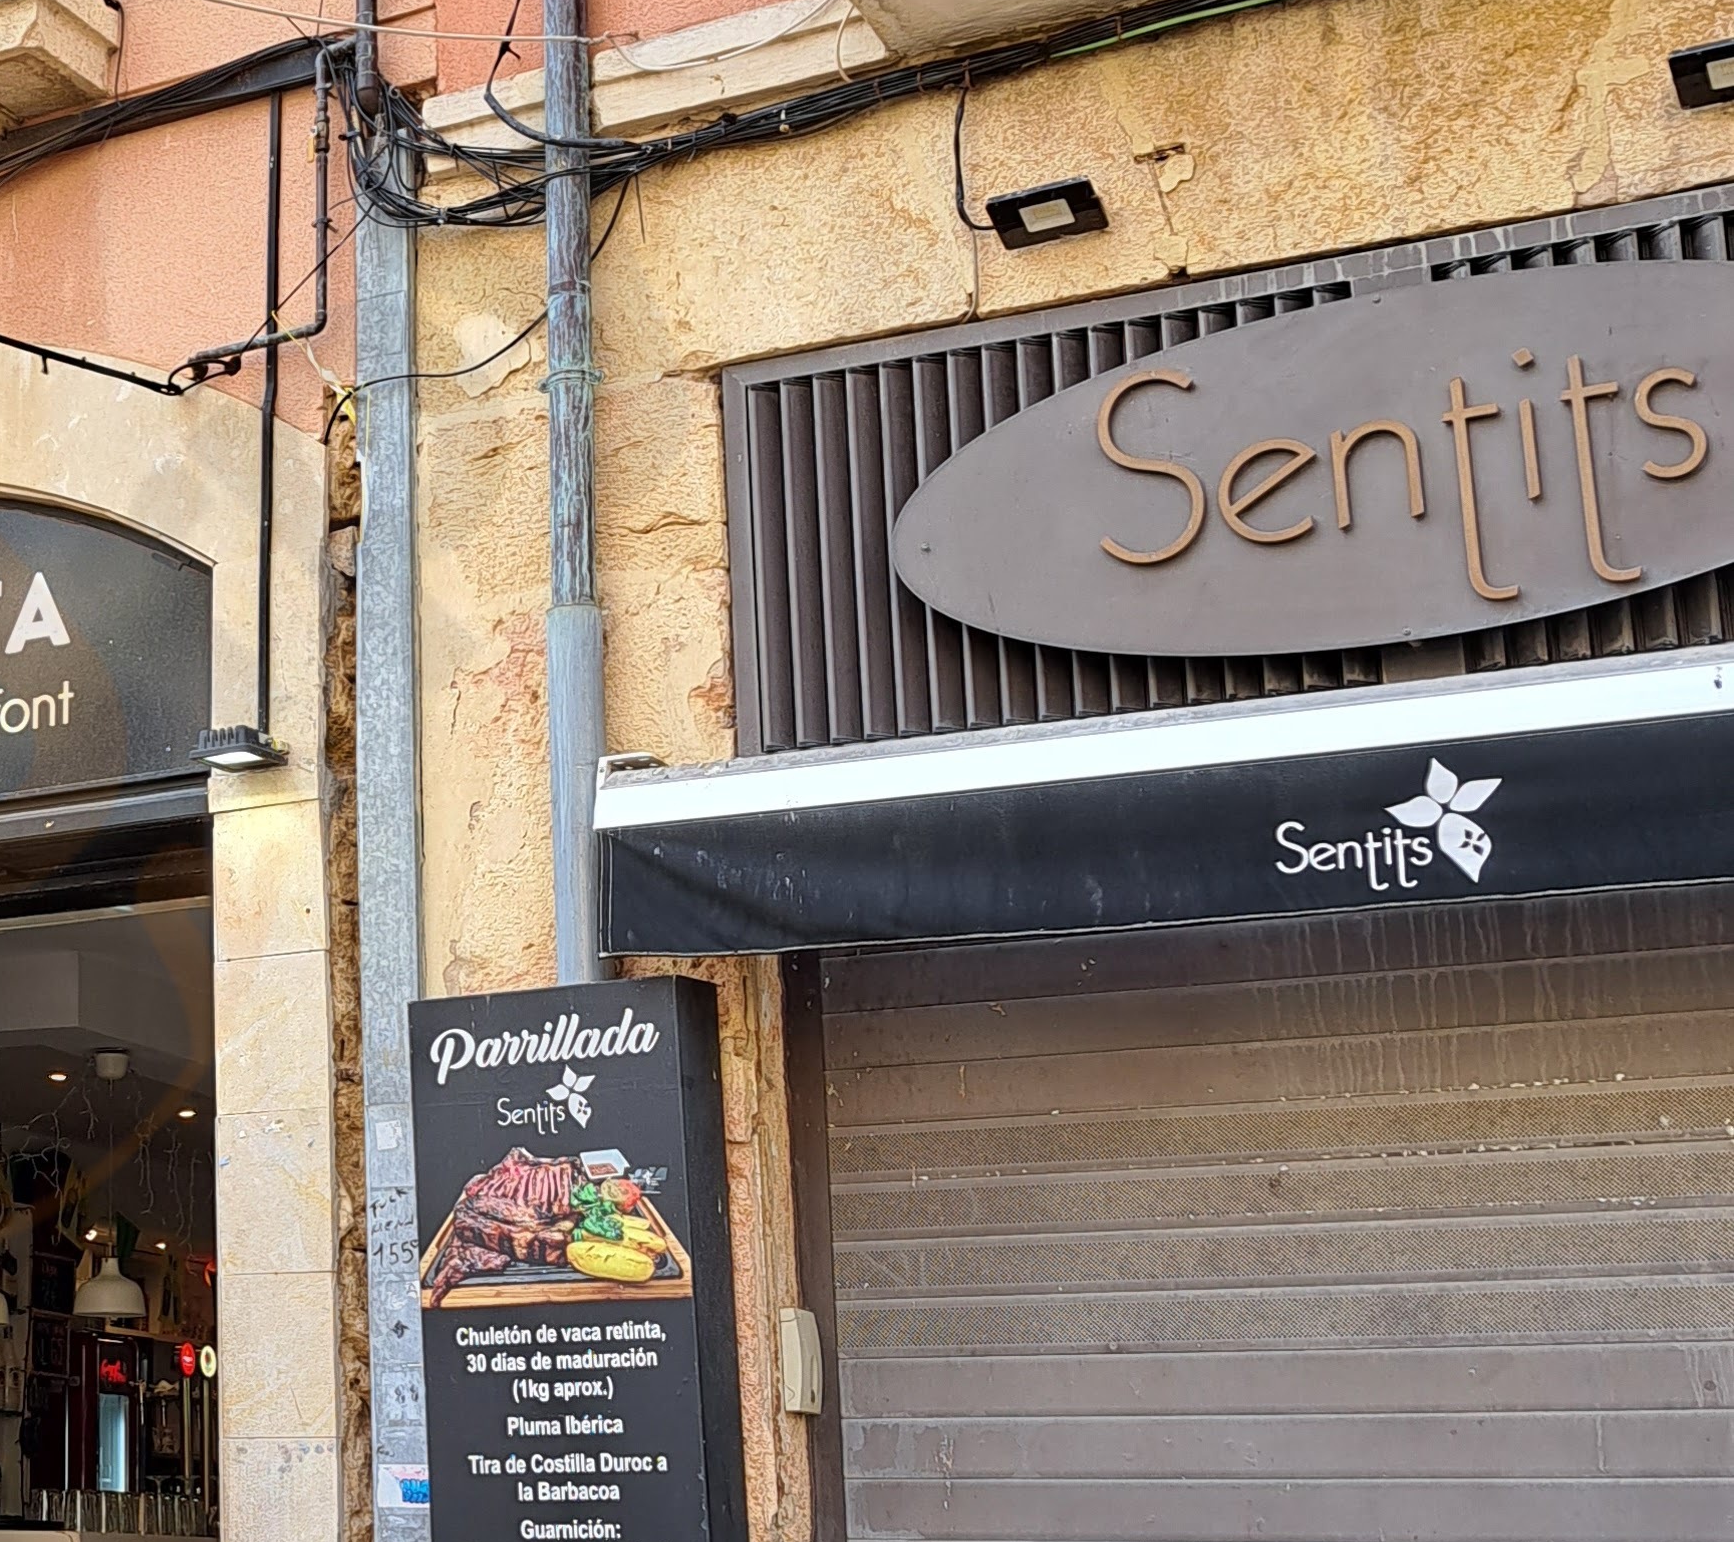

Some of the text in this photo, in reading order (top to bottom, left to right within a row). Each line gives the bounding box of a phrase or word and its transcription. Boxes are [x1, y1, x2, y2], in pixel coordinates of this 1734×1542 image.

[1096, 347, 1709, 601] Sentits
[1275, 822, 1433, 891] Sentits
[430, 1007, 660, 1086] Parrillada
[497, 1098, 566, 1135] Sentits
[455, 1320, 667, 1347] Chuletón de vaca retinta,
[466, 1346, 658, 1373] 30 días de maduración
[512, 1375, 614, 1404] (1kg aprox.)
[506, 1414, 624, 1437] Pluma Ibérica
[467, 1452, 668, 1475] Tira de Costilla Duroc a
[517, 1480, 621, 1502] la Barbacoa
[520, 1518, 622, 1541] Guarnición:
